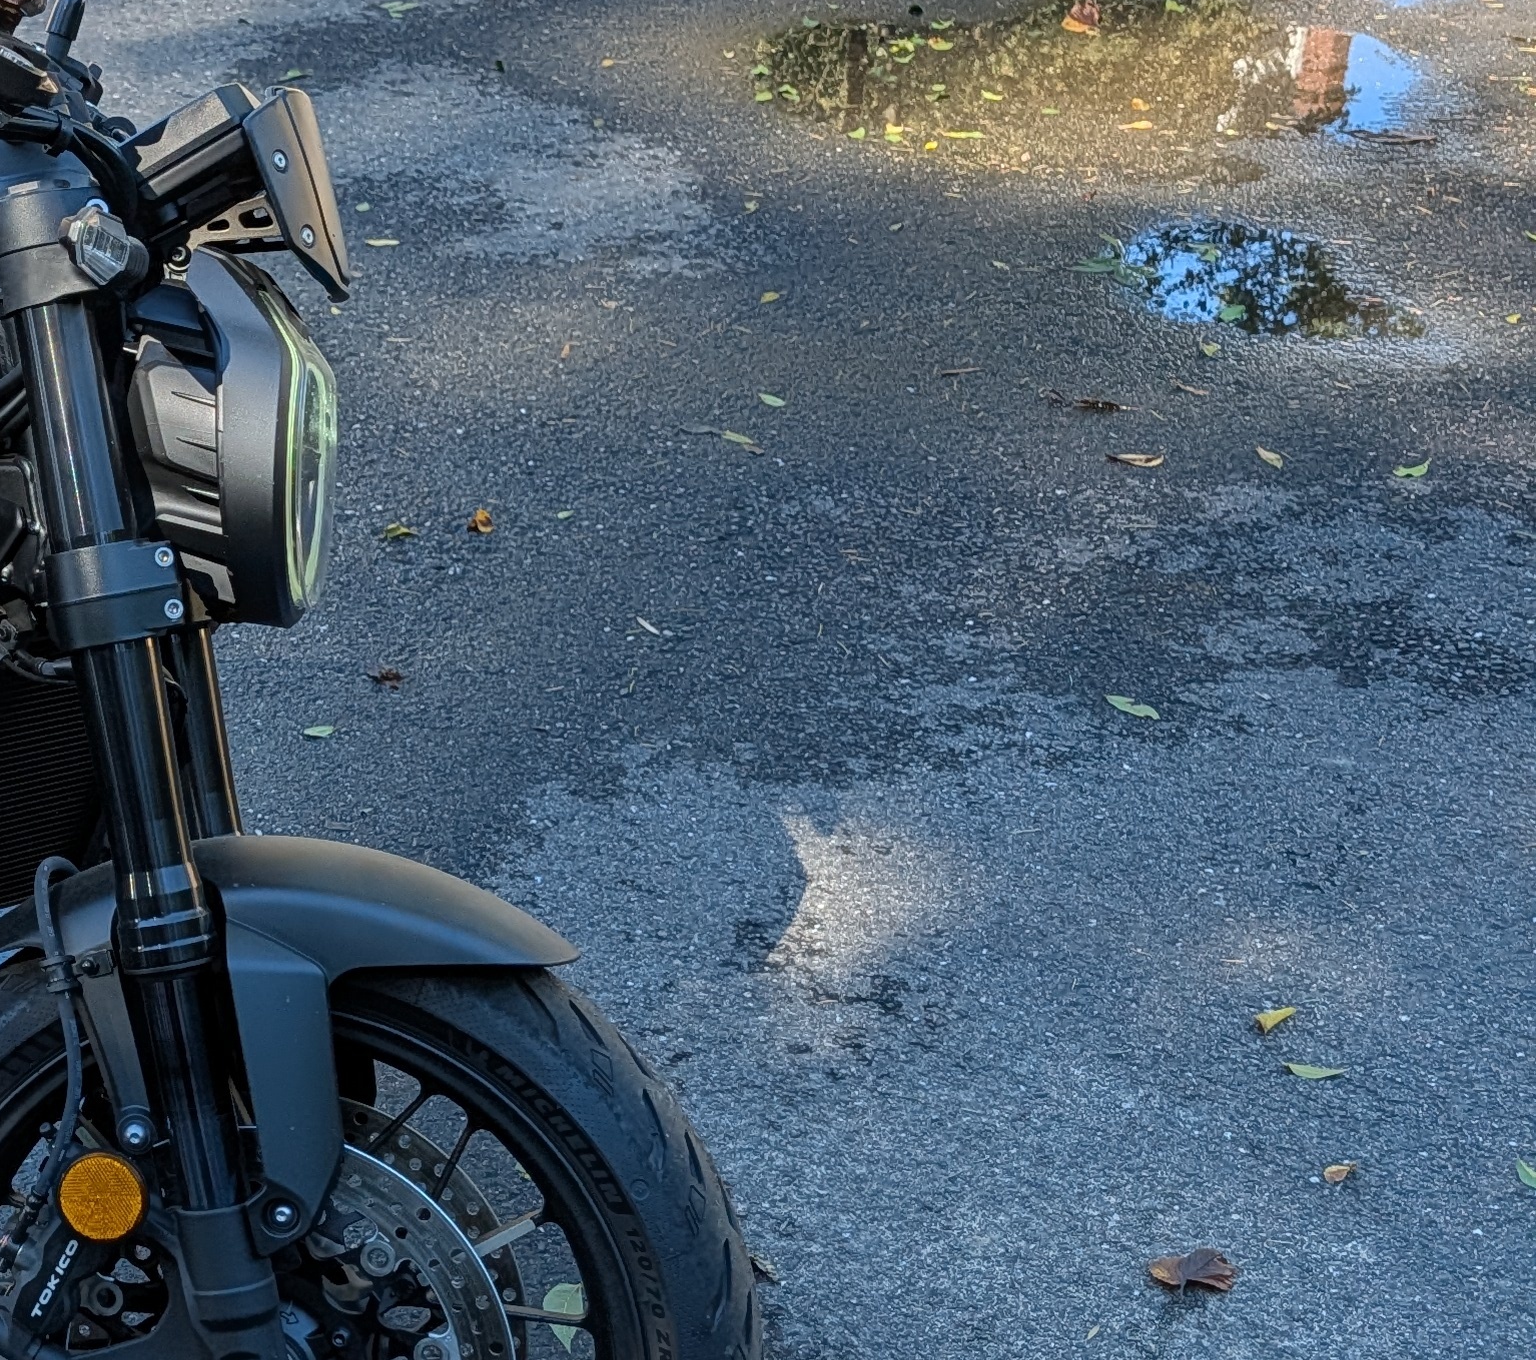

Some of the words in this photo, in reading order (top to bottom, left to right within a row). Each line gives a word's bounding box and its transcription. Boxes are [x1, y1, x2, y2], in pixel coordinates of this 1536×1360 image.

[496, 1065, 623, 1204] MICHELIN
[30, 1239, 79, 1318] TOKICO
[626, 1227, 666, 1319] 120/70
